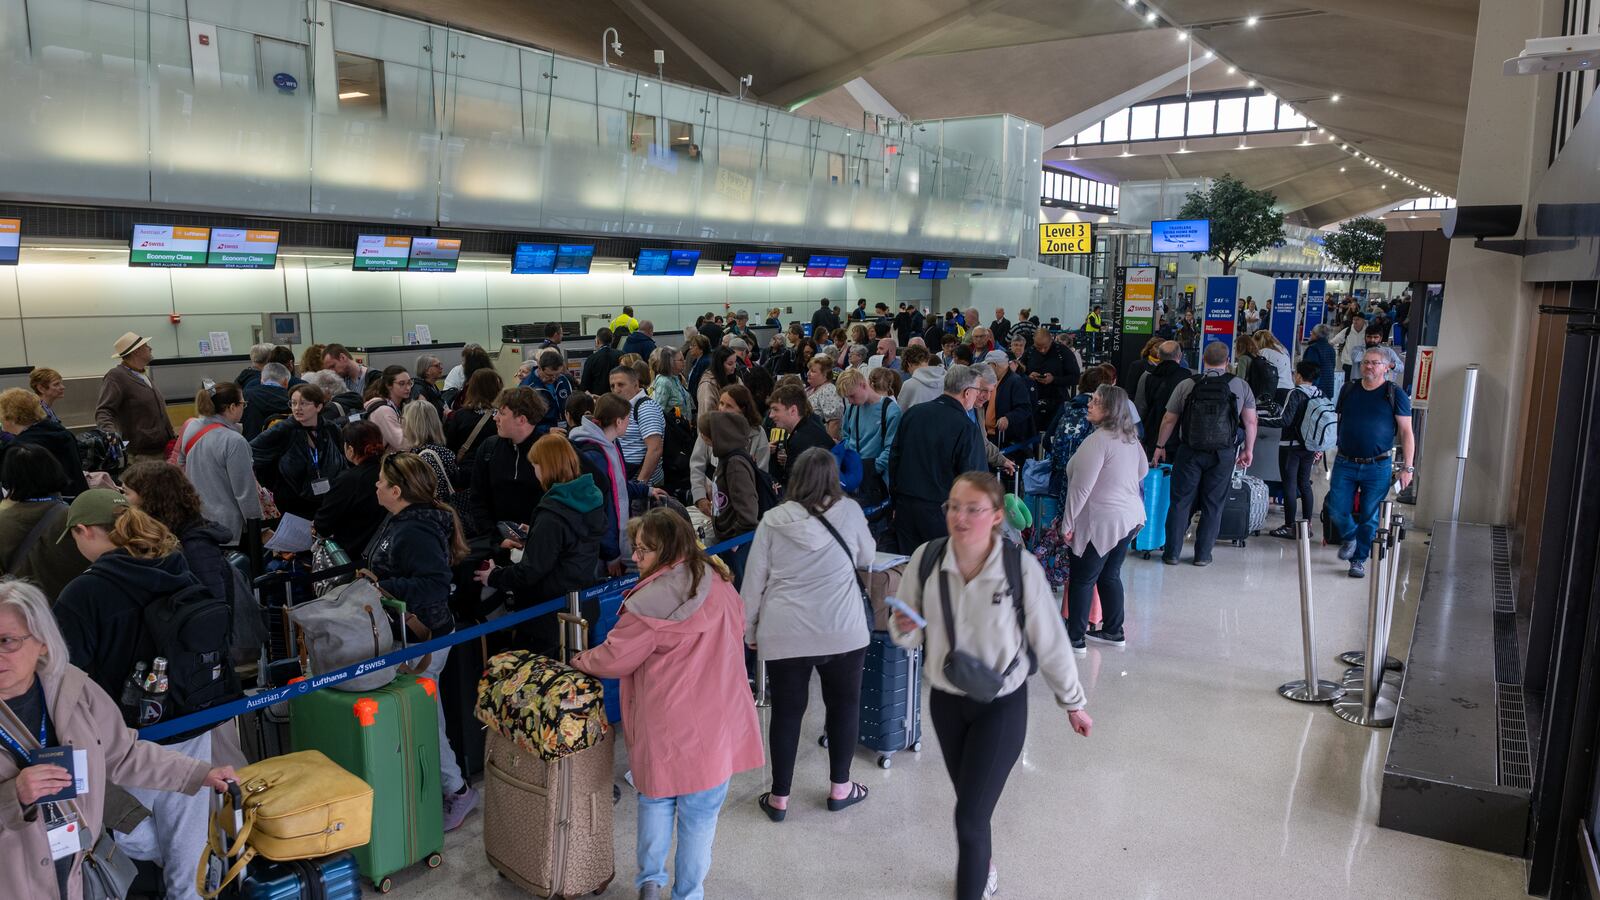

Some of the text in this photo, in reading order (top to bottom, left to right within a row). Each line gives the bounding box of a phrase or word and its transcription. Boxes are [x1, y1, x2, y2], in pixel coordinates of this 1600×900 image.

[1045, 224, 1085, 238] Level 3
[1046, 239, 1084, 252] Zone C
[147, 253, 175, 261] Economy
[1115, 279, 1124, 327] ALLIANCE
[246, 658, 386, 709] Austrian Lufthansa SWISS
